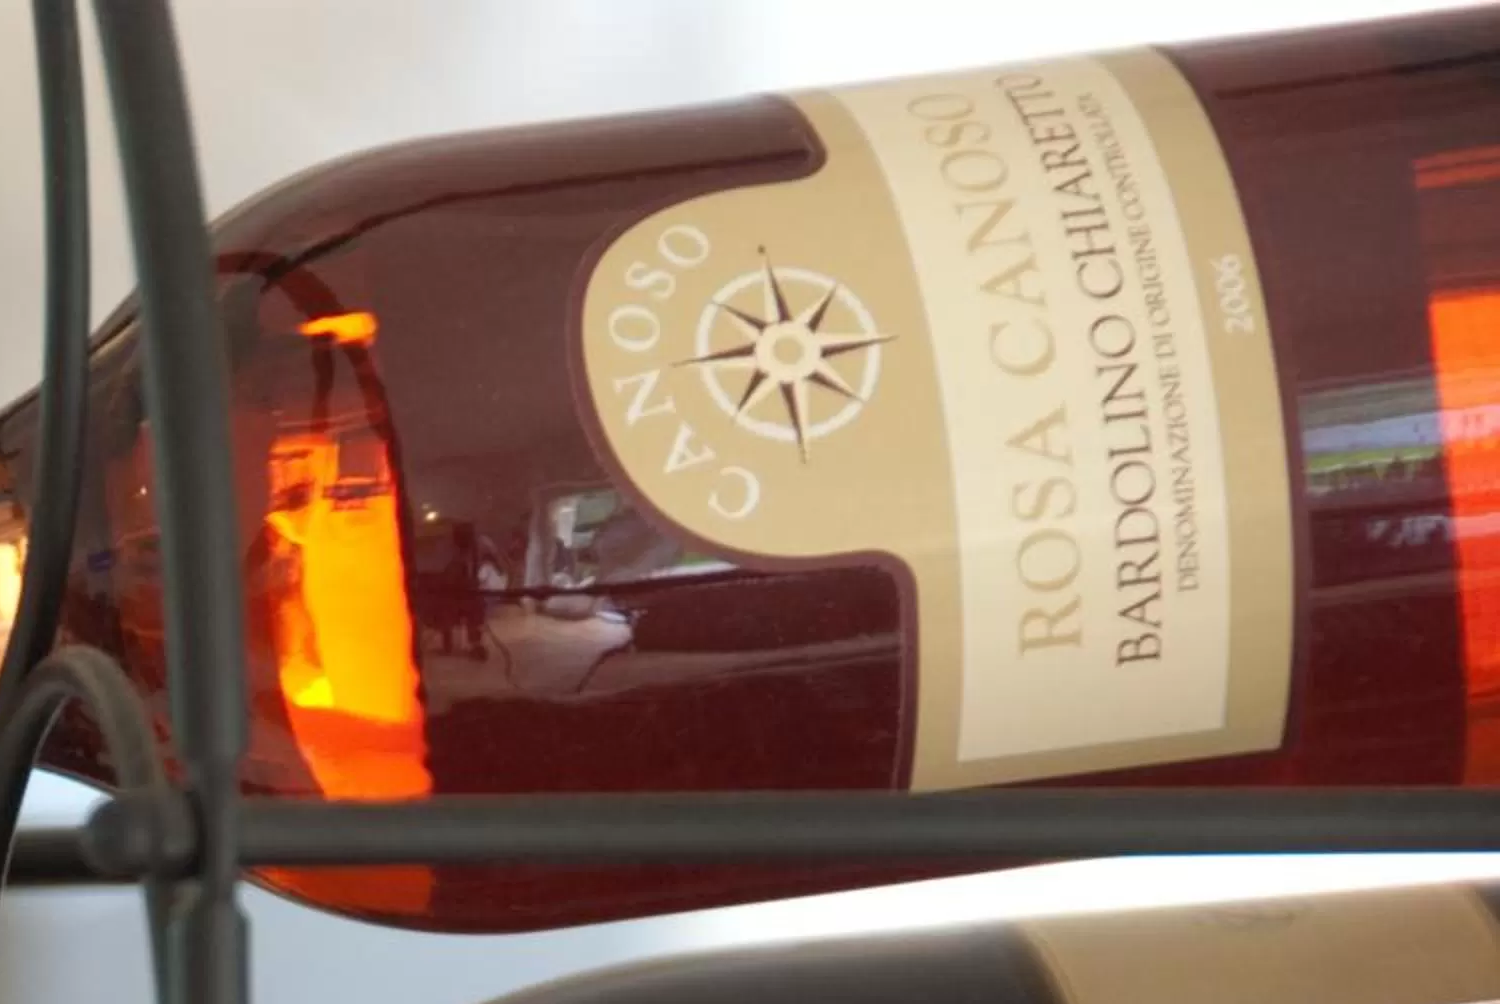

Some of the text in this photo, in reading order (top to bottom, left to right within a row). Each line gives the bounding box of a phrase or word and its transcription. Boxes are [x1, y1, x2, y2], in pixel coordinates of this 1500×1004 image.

[610, 222, 761, 521] CANOSO
[907, 93, 1082, 656] ROSA CANOSO
[994, 71, 1162, 668] BARDOLINO CHIARETTO
[1129, 225, 1174, 330] ORIGINE
[1152, 331, 1176, 359] DI
[1210, 254, 1254, 334] 2006
[1159, 368, 1200, 592] DENOMINAZIONE
